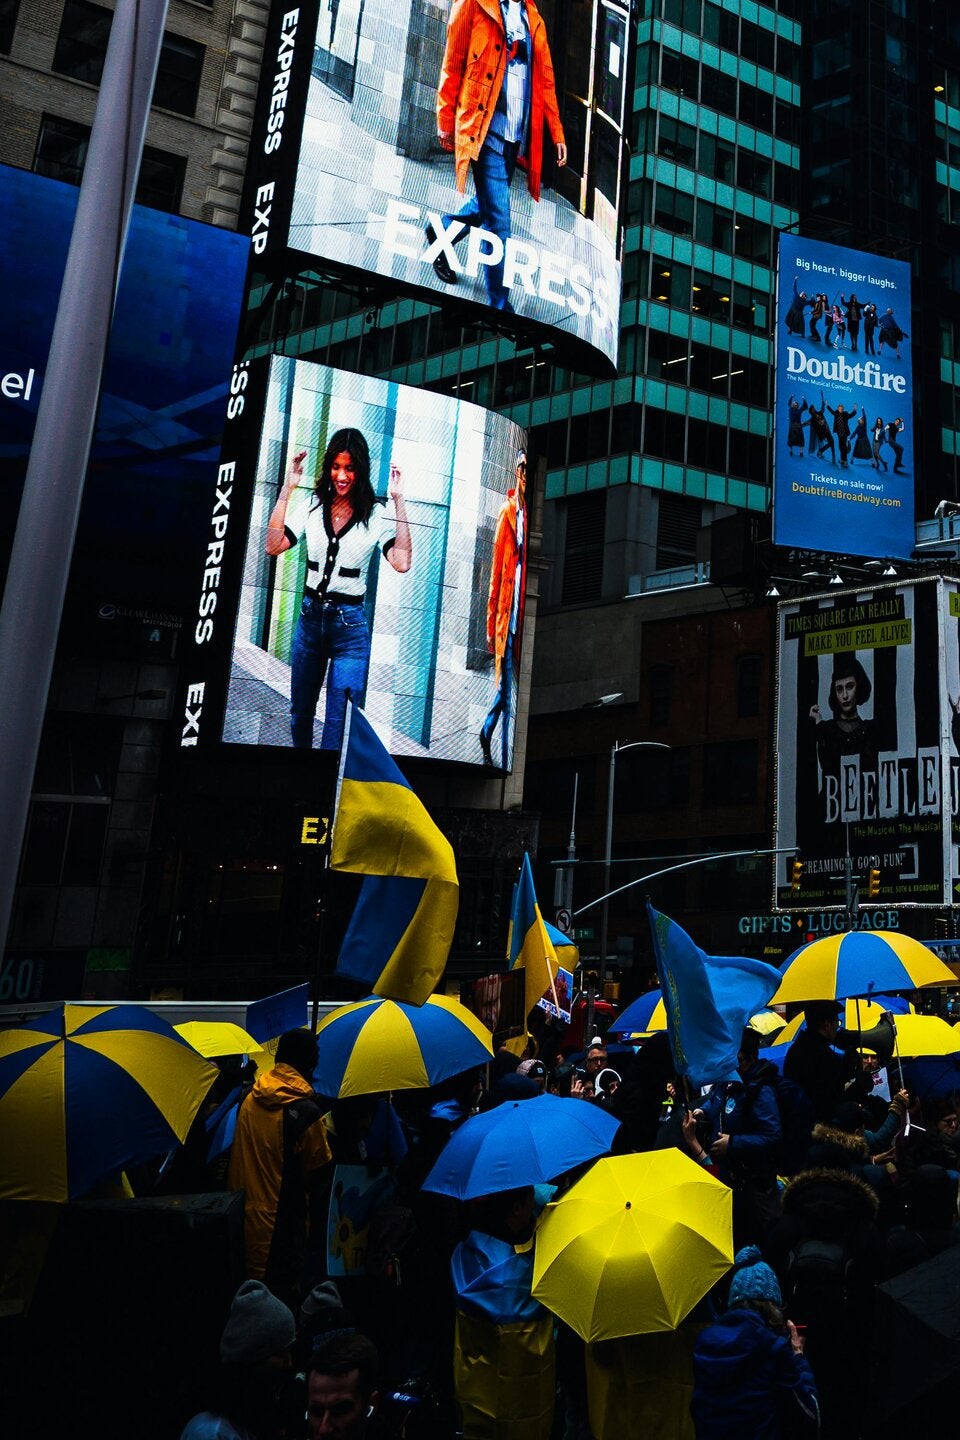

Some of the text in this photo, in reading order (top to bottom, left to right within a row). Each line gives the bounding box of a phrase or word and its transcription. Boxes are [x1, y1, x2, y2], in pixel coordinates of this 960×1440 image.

[263, 8, 300, 155] EXPRESS
[251, 181, 276, 256] EXP
[383, 198, 610, 329] EXPRESS
[796, 258, 897, 290] Big heart, bigger laughs.
[786, 346, 906, 394] Doubtfire
[787, 373, 797, 382] The
[810, 378, 830, 389] Musical
[831, 381, 853, 393] Comedy
[226, 360, 251, 420] SS
[792, 482, 901, 507] DoubtfireBroadway.com
[810, 473, 884, 492] Tickets on sale now!
[195, 461, 237, 646] EXPRESS
[788, 599, 901, 634] TIMES SQUARE CAN REALLY
[808, 623, 909, 651] MAKE YOU FEEL ALIVE!
[853, 827, 867, 838] The
[899, 823, 912, 834] The
[913, 821, 941, 833] Musical
[738, 910, 900, 934] GIFTS LUGGAGE
